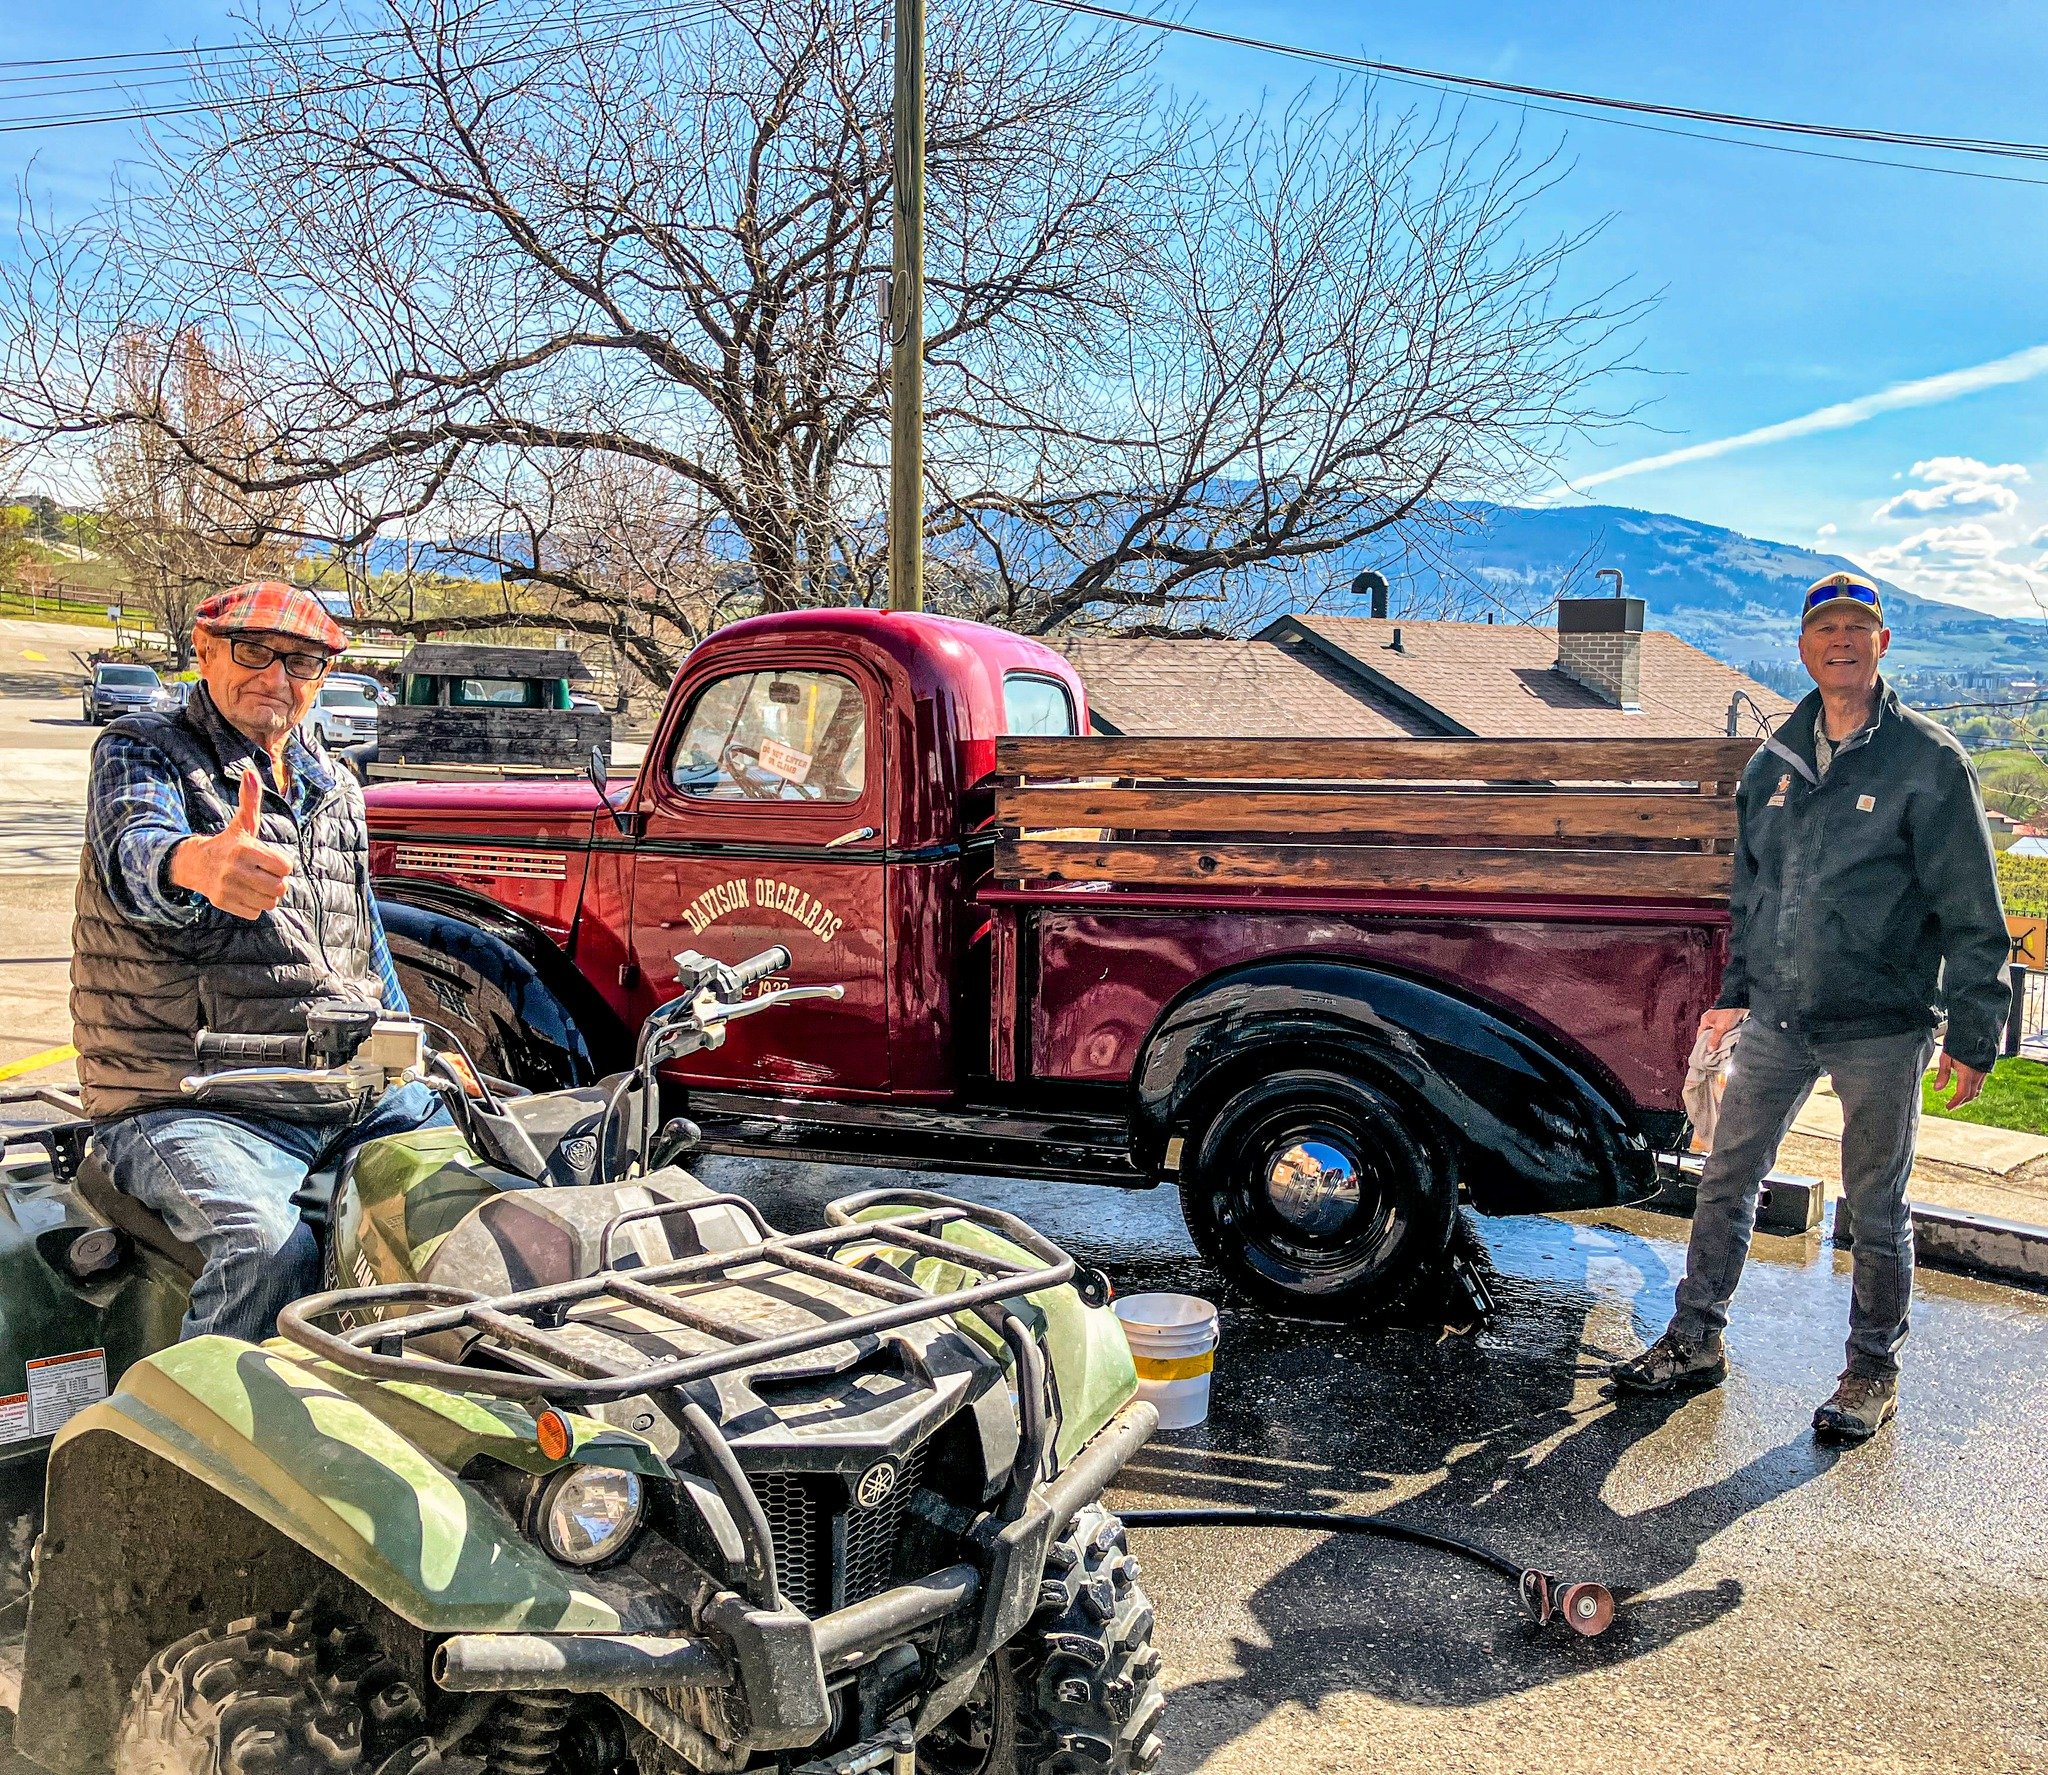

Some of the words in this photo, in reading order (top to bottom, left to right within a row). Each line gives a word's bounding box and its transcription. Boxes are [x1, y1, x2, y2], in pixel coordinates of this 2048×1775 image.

[772, 749, 783, 760] NOT
[785, 754, 808, 769] ENTER
[776, 760, 798, 774] CLIMB
[682, 878, 749, 936] DAVISON
[755, 877, 843, 943] ORCHARDS
[353, 1248, 385, 1322] YAMA
